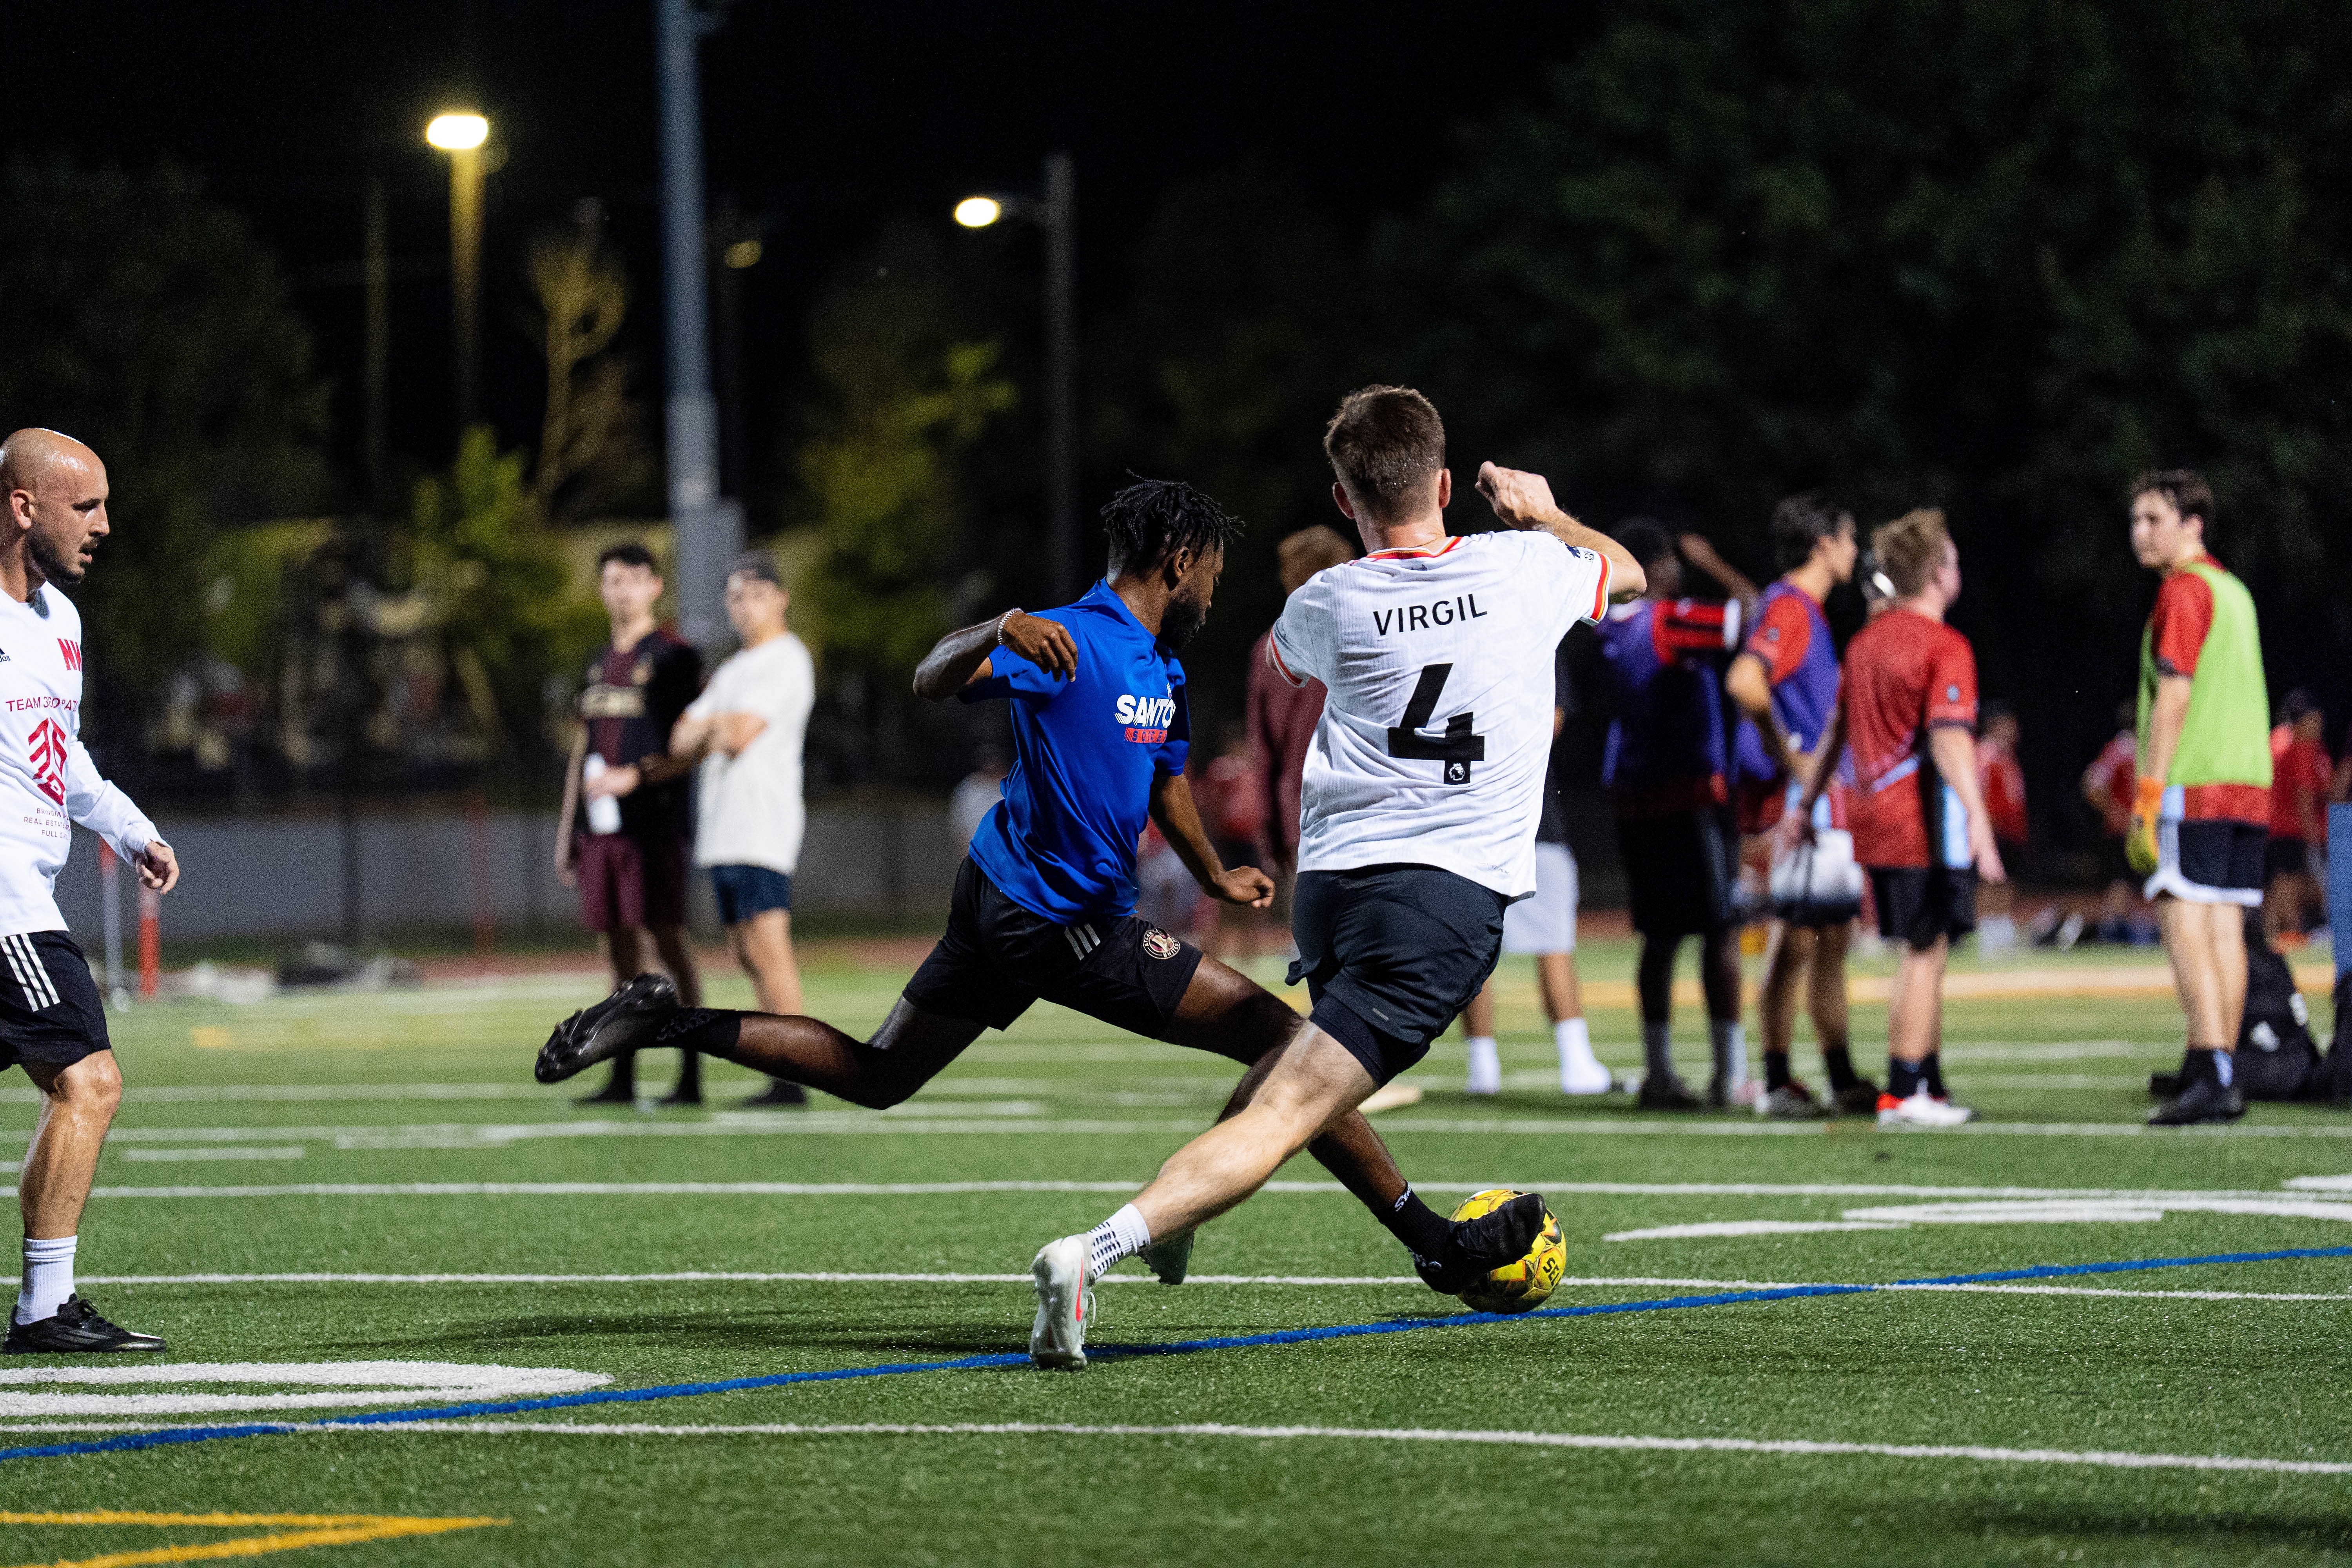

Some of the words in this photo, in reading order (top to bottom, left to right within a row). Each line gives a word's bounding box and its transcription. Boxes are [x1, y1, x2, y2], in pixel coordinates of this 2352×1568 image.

[1373, 593, 1488, 636] VIRGIL
[5, 697, 41, 712] TEAM
[1388, 662, 1485, 784] 4
